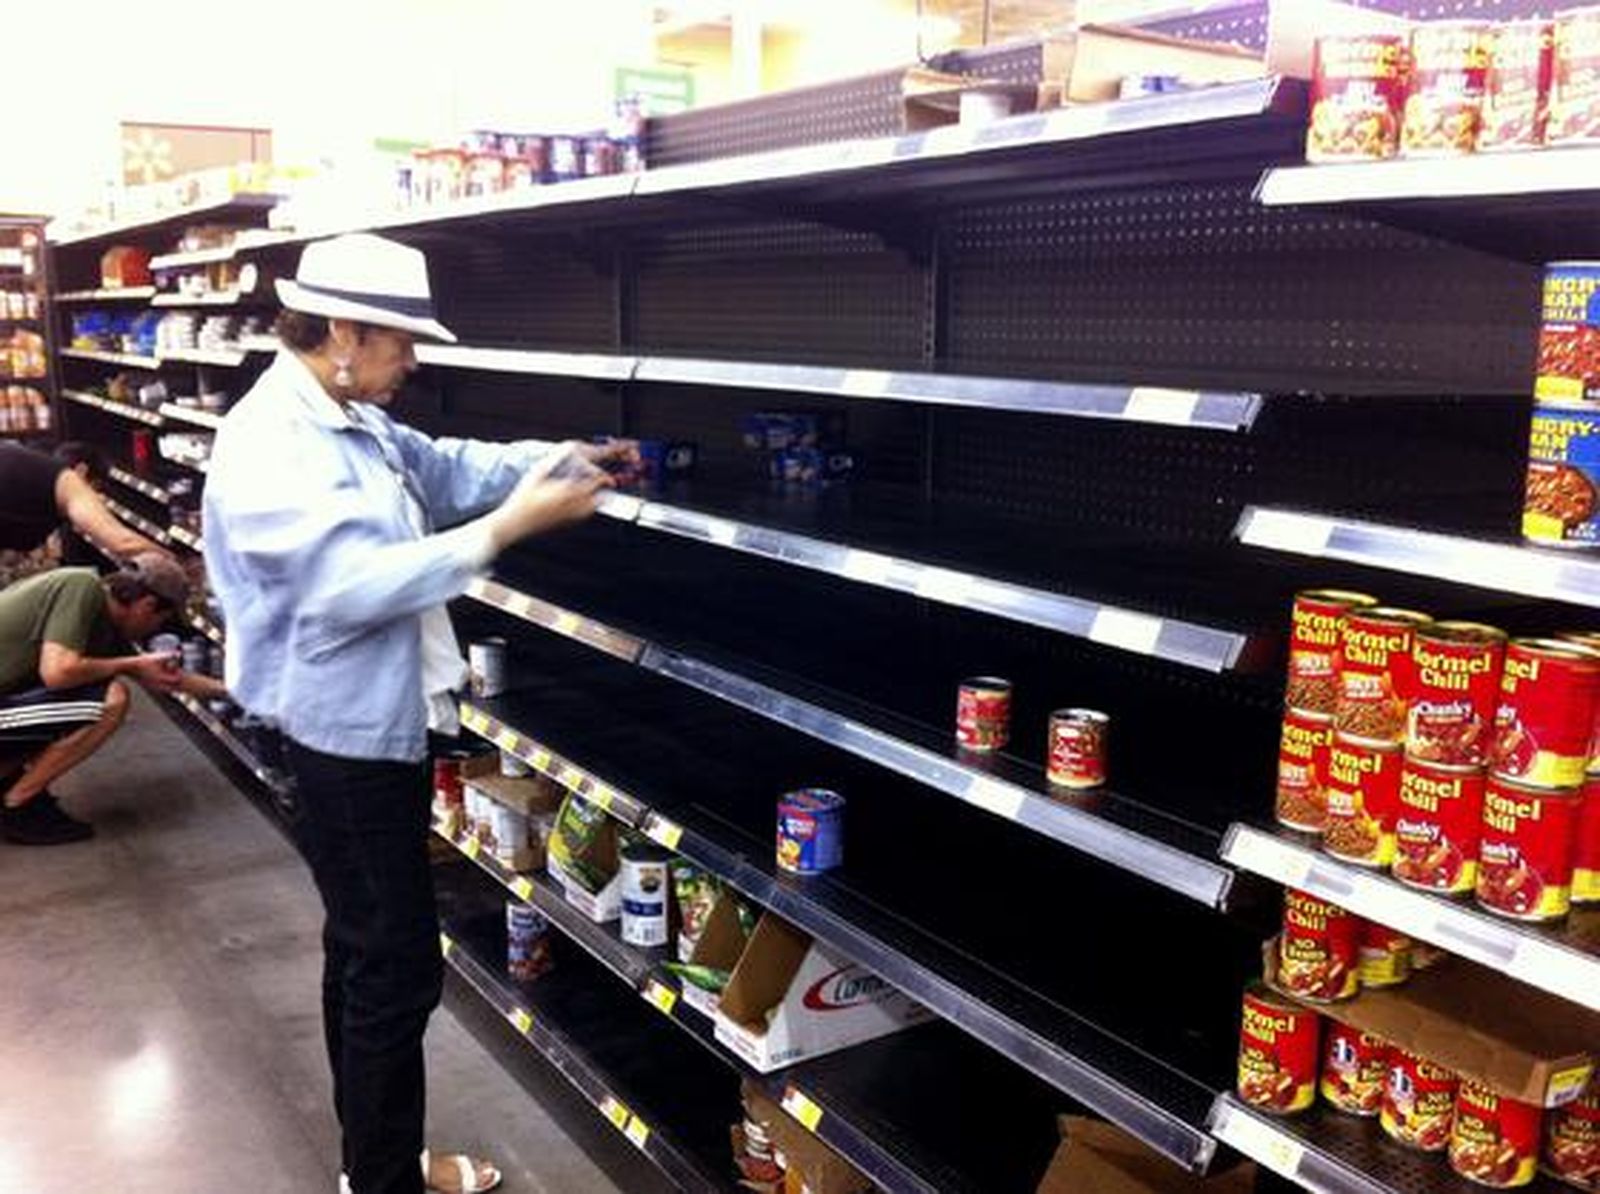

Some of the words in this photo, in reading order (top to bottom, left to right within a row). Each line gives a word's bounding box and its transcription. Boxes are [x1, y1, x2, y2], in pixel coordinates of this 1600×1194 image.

[1343, 628, 1409, 652] ormel
[1345, 644, 1387, 667] Chili
[1420, 668, 1469, 691] Chili
[1287, 908, 1327, 931] Chili
